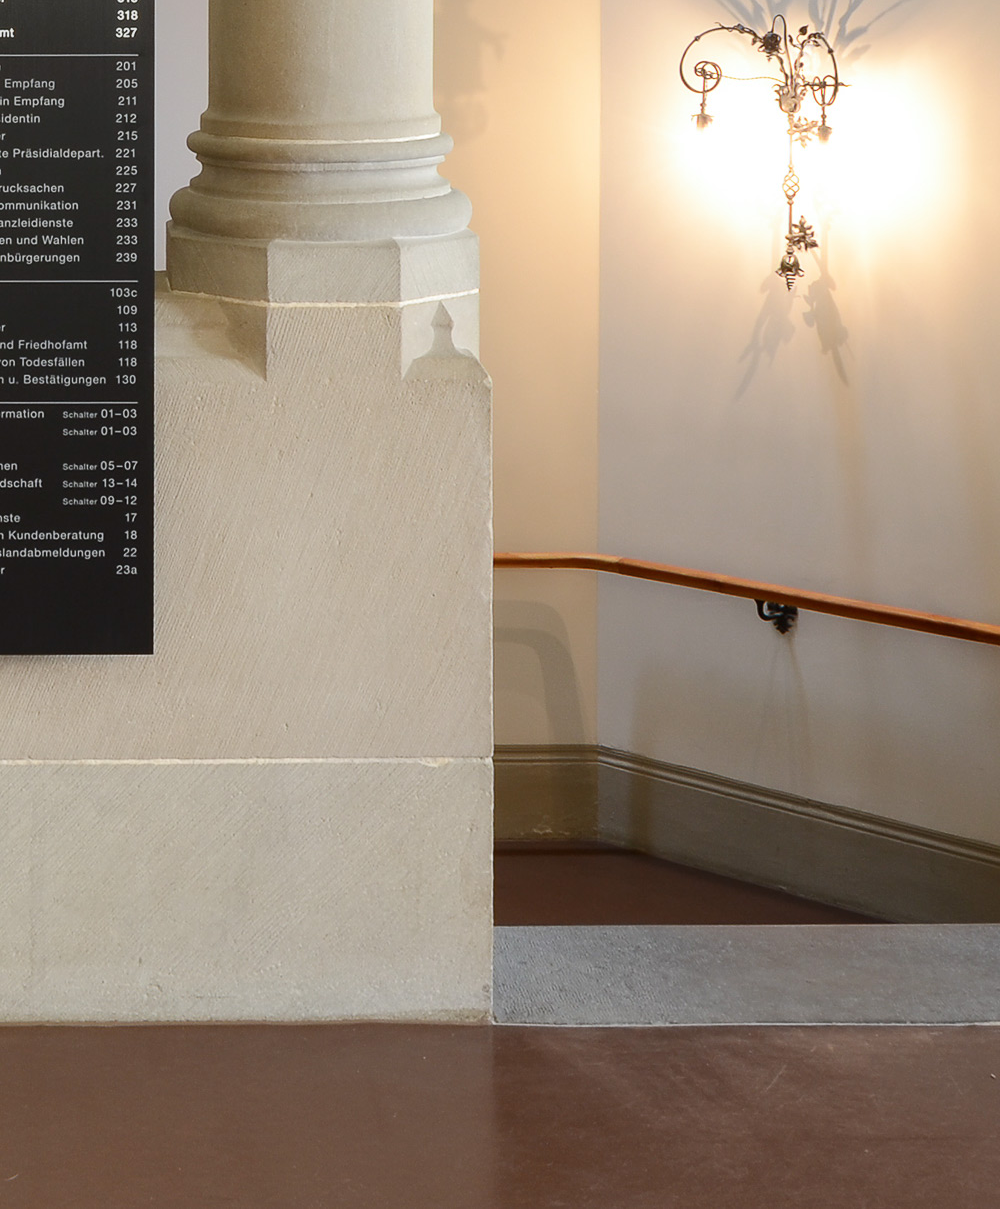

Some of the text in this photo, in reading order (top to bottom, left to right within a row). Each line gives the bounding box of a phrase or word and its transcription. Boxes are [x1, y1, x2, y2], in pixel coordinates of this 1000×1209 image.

[116, 10, 139, 21] 318
[115, 27, 138, 39] 327
[115, 61, 136, 72] 201
[4, 79, 56, 91] Empfang
[115, 79, 139, 89] 205
[13, 96, 65, 109] Empfang
[117, 96, 137, 106] 211
[115, 113, 137, 124] 212
[117, 131, 139, 141] 215
[12, 148, 105, 161] Präsidialdepart.
[115, 148, 136, 159] 221
[115, 166, 138, 176] 225
[114, 183, 137, 193] 227
[116, 200, 137, 211] 231
[115, 218, 139, 228] 233
[16, 235, 39, 246] und
[41, 235, 85, 246] Wahlen
[115, 235, 138, 246] 233
[115, 253, 138, 263] 239
[109, 288, 138, 298] 103c
[116, 305, 138, 316] 109
[118, 323, 138, 333] 113
[17, 340, 88, 350] Friedhofamt
[118, 340, 138, 350] 118
[19, 357, 86, 368] Todesfällen
[118, 357, 138, 368] 118
[8, 377, 19, 385] u.
[23, 374, 107, 388] Bestätigungen
[115, 375, 137, 385] 130
[62, 411, 98, 419] Schalter
[62, 428, 98, 437] Schalter
[62, 463, 98, 471] Schalter
[62, 480, 98, 489] Schalter
[62, 498, 98, 506] Schalter
[124, 513, 138, 523] 17
[8, 530, 105, 543] Kundenberatung
[124, 530, 138, 541] 18
[122, 548, 138, 558] 22
[115, 565, 138, 575] 23a
